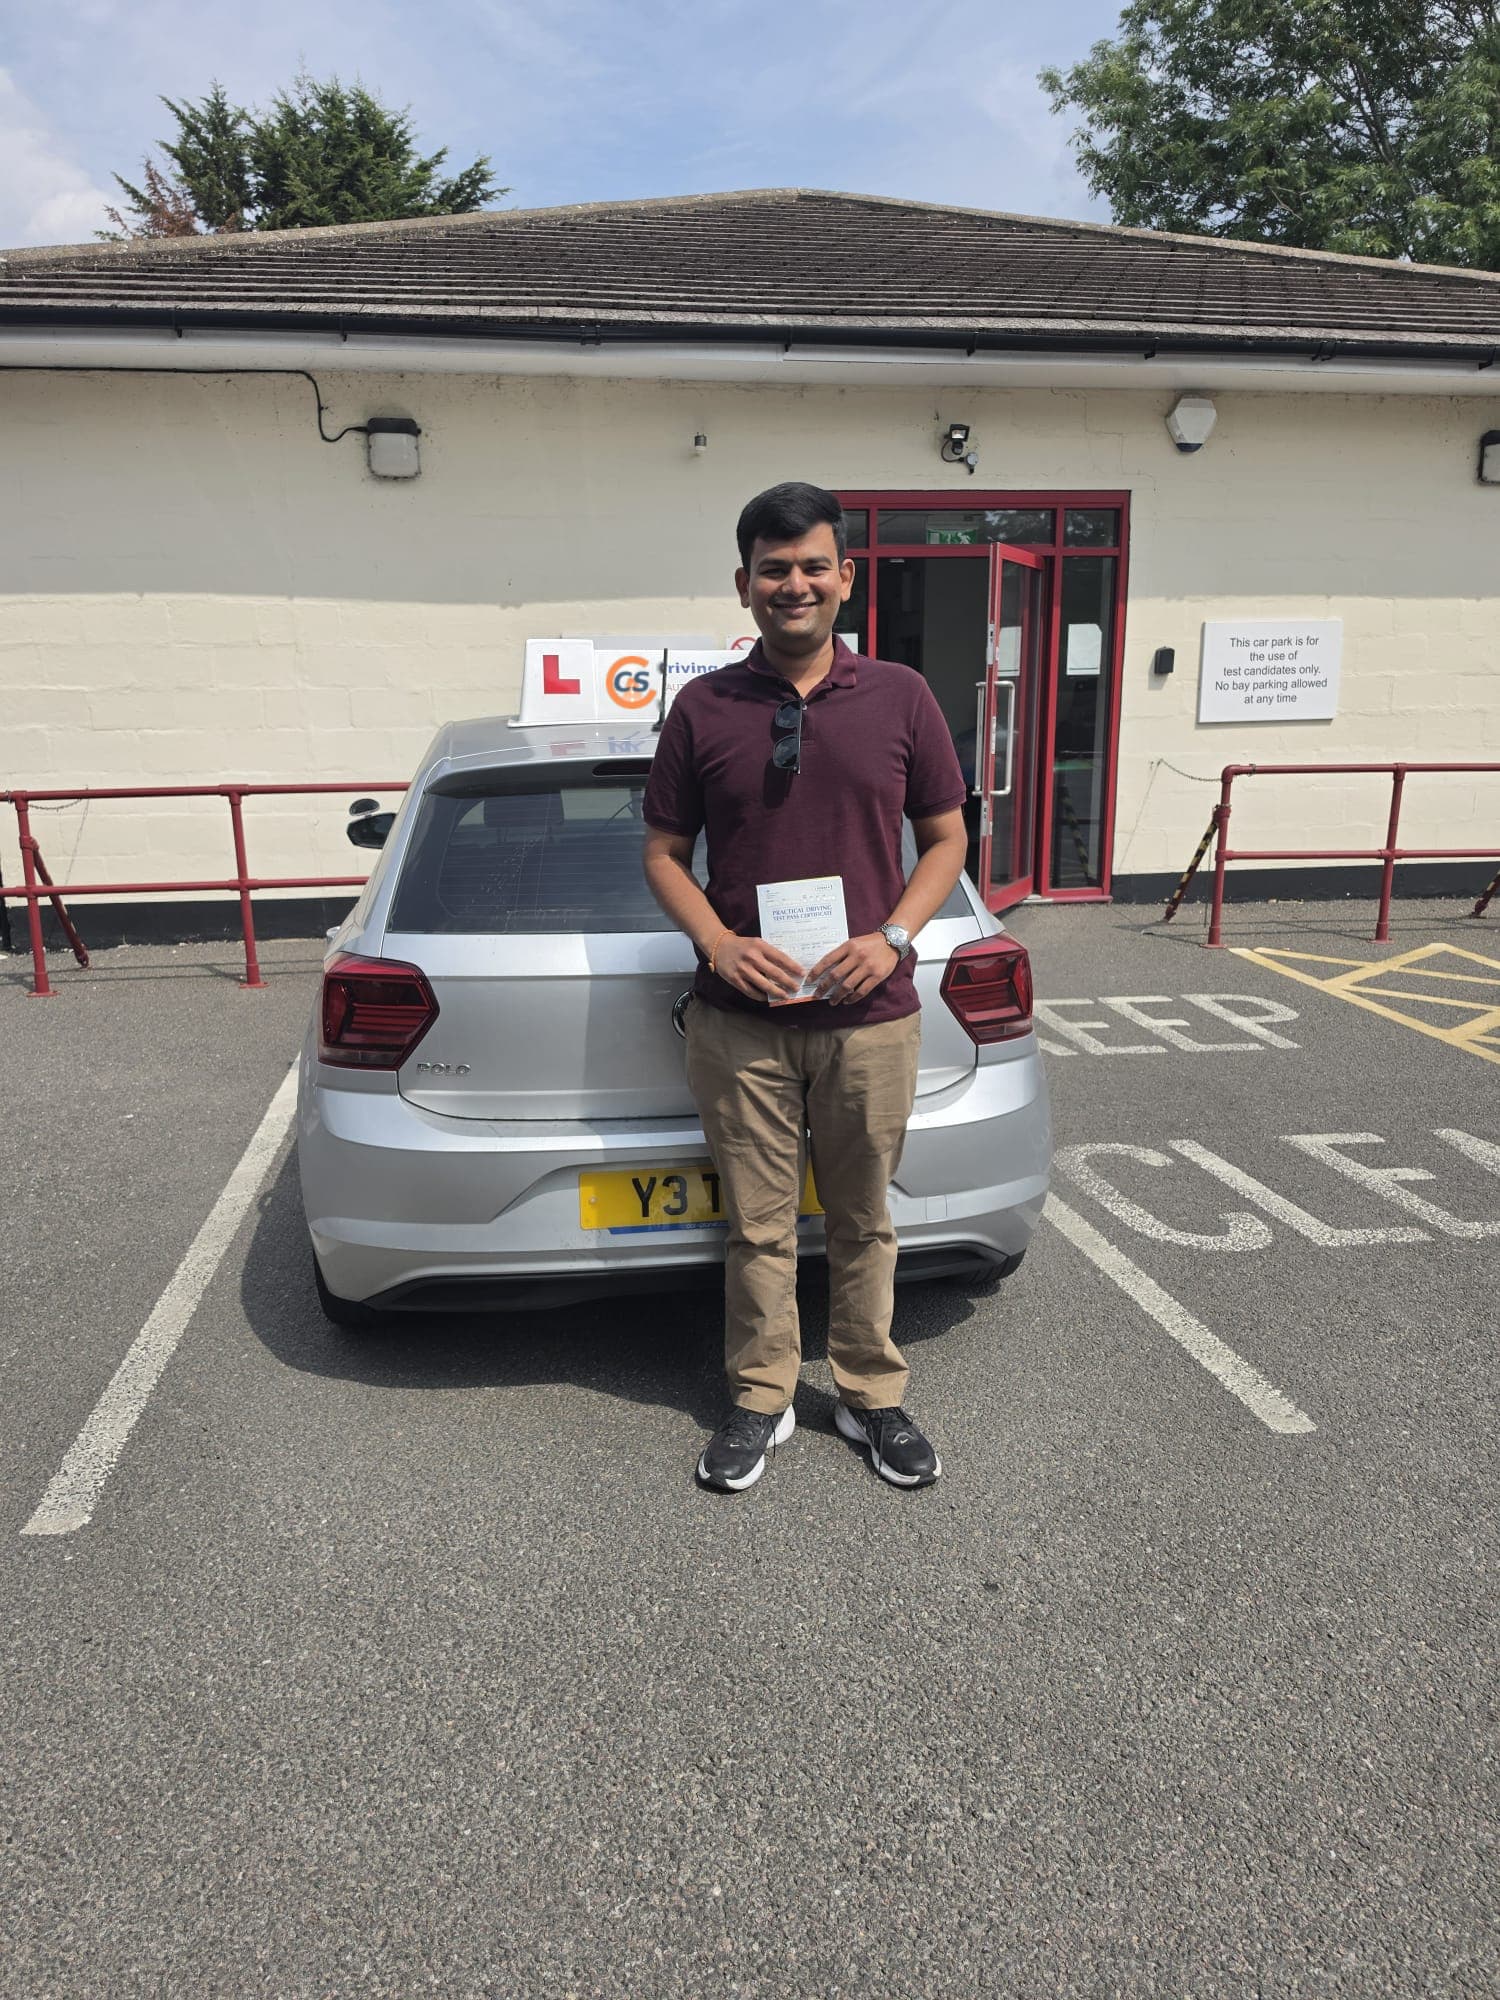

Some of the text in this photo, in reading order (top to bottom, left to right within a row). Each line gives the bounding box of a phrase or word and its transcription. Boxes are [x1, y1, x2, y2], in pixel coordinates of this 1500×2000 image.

[1230, 636, 1319, 648] This car park is for
[1250, 651, 1298, 661] the use of
[542, 654, 581, 694] L
[666, 662, 718, 674] riving
[1224, 664, 1321, 677] test candidates only.
[1215, 678, 1328, 692] No bay parking allowed
[1244, 693, 1297, 705] at any time
[773, 908, 804, 916] PRACTICAL
[417, 1062, 471, 1075] POLO
[631, 1175, 688, 1218] Y3
